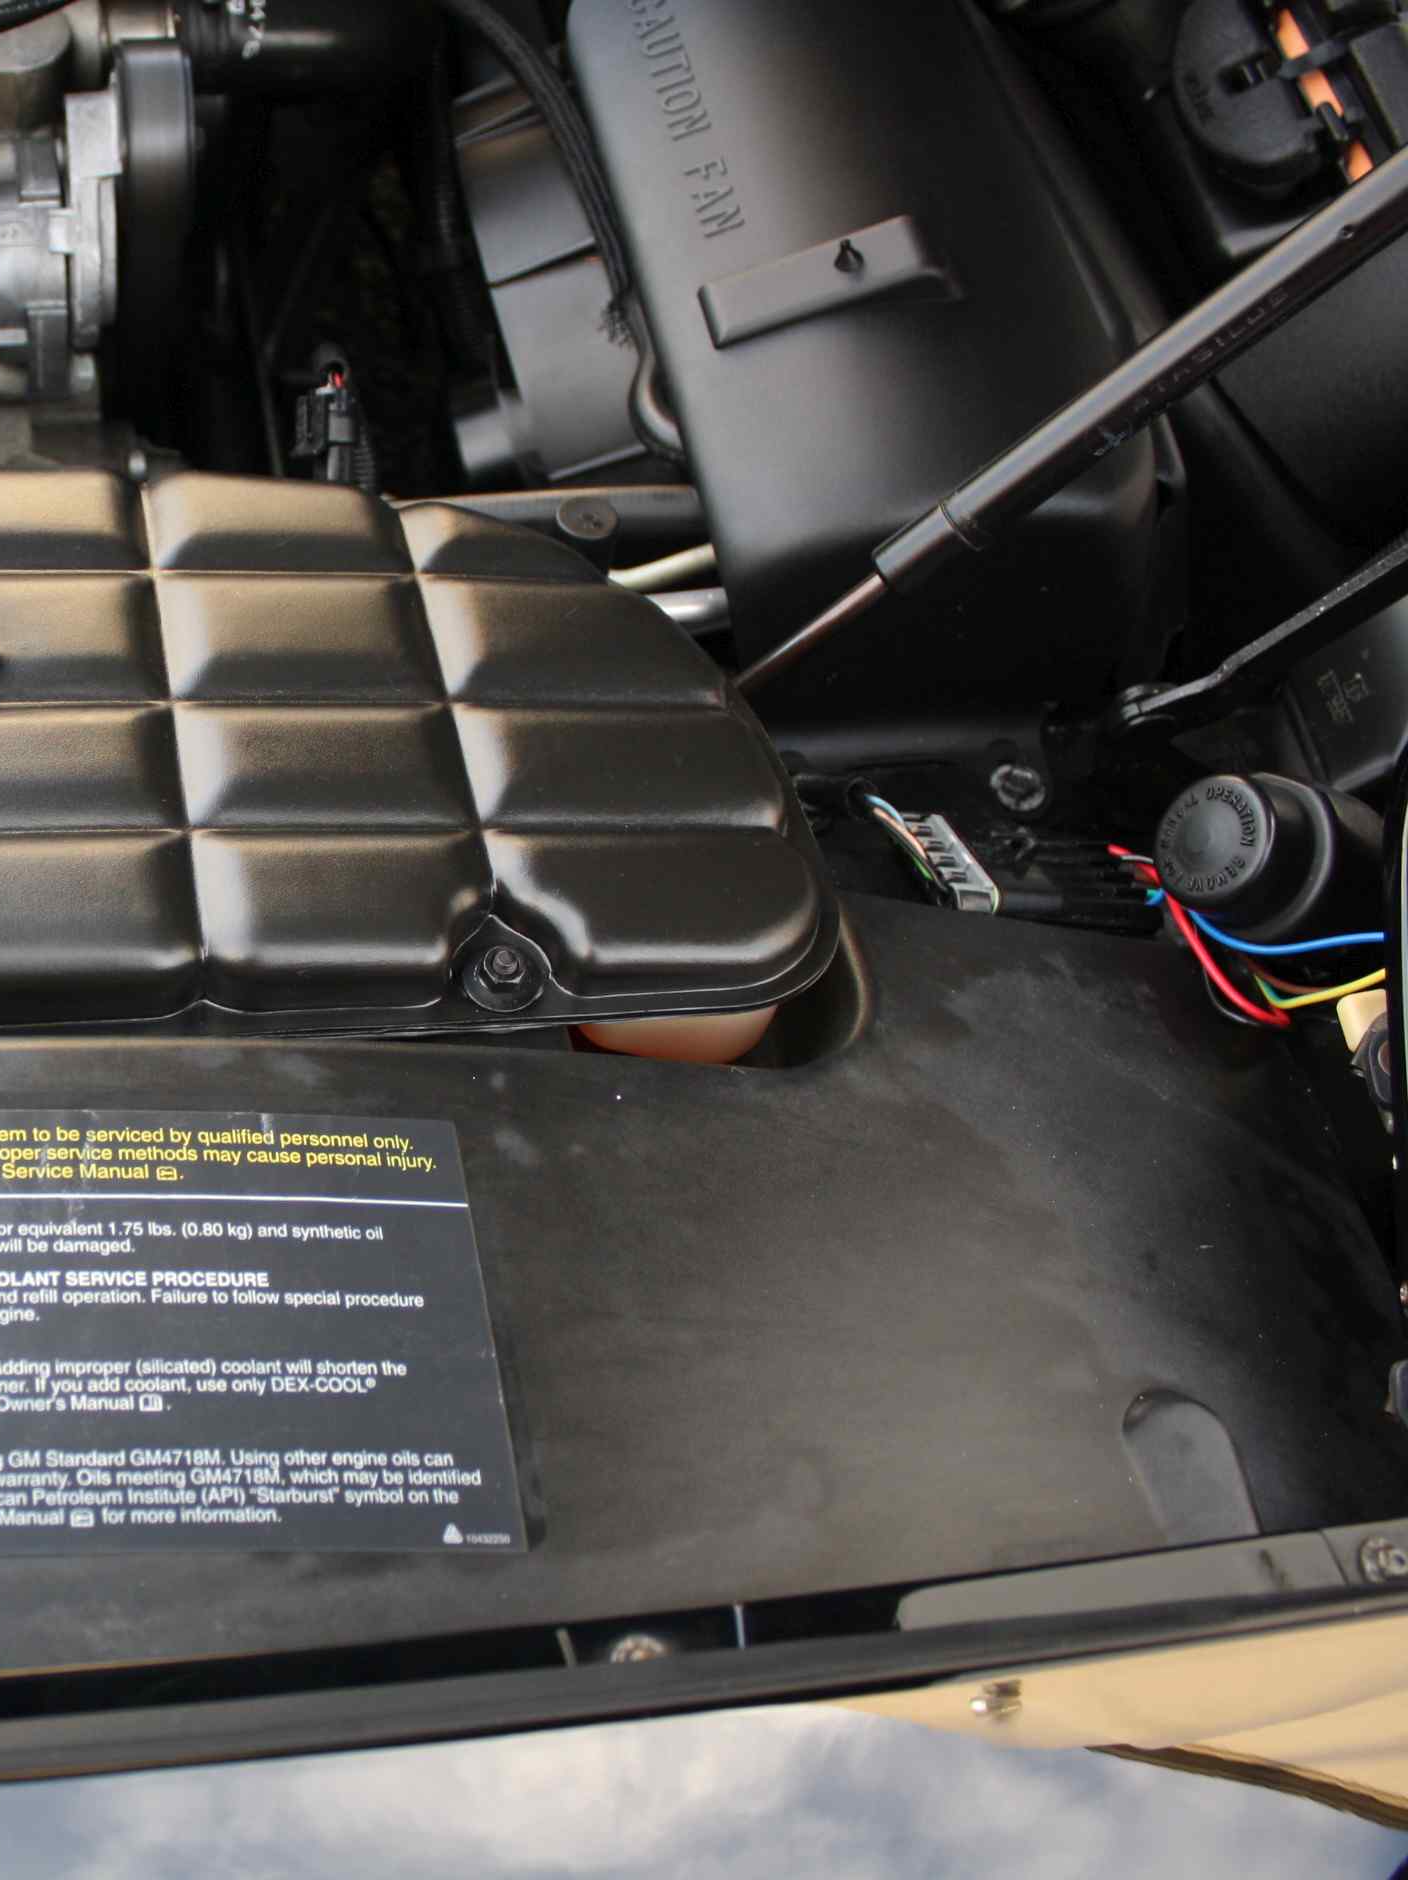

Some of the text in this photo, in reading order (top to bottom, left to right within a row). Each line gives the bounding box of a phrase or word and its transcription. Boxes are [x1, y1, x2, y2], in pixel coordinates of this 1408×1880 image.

[684, 156, 745, 238] FAN
[1205, 784, 1257, 848] OPERATION
[32, 1127, 51, 1143] to
[55, 1127, 80, 1143] be
[85, 1127, 164, 1144] serviced
[168, 1129, 192, 1148] by
[196, 1129, 275, 1150] qualified
[279, 1131, 368, 1152] personnel
[372, 1133, 414, 1152] only.
[44, 1145, 113, 1161] service
[117, 1146, 198, 1162] methods
[202, 1149, 242, 1166] may
[246, 1150, 302, 1164] cause
[305, 1149, 382, 1171] personal
[386, 1152, 437, 1172] injury.
[1, 1164, 74, 1179] Service
[78, 1164, 150, 1179] Manual
[16, 1220, 103, 1239] equivalent
[107, 1220, 144, 1236] 1.75
[147, 1221, 176, 1236] lbs.
[180, 1221, 224, 1239] (0.80
[226, 1222, 253, 1241] kg)
[257, 1222, 288, 1238] and
[291, 1223, 362, 1243] synthetic
[364, 1225, 384, 1240] oil
[26, 1238, 49, 1253] be
[52, 1237, 136, 1256] damaged.
[64, 1271, 148, 1287] SERVICE
[151, 1271, 270, 1287] PROCEDURE
[22, 1289, 58, 1304] refill
[61, 1289, 146, 1307] operation.
[150, 1289, 208, 1304] Failure
[211, 1289, 229, 1305] to
[232, 1290, 280, 1305] follow
[283, 1291, 341, 1310] special
[344, 1291, 425, 1310] procedure
[54, 1359, 132, 1378] improper
[134, 1359, 217, 1377] (silicated)
[220, 1359, 282, 1375] coolant
[284, 1359, 312, 1375] will
[316, 1359, 378, 1375] shorten
[380, 1360, 408, 1376] the
[34, 1378, 46, 1393] If
[49, 1380, 83, 1397] you
[86, 1377, 120, 1392] add
[123, 1377, 192, 1395] coolant,
[195, 1379, 228, 1392] use
[230, 1377, 266, 1396] only
[70, 1395, 135, 1411] Manual
[6, 1451, 41, 1468] GM
[44, 1450, 126, 1467] Standard
[128, 1450, 226, 1466] GM4718M.
[229, 1450, 280, 1469] Using
[283, 1450, 328, 1466] other
[331, 1450, 388, 1469] engine
[390, 1450, 420, 1466] oils
[422, 1453, 455, 1466] can
[75, 1469, 112, 1486] Oils
[115, 1468, 186, 1489] meeting
[189, 1468, 286, 1487] GM4718M,
[288, 1468, 339, 1484] which
[342, 1471, 378, 1488] may
[381, 1468, 404, 1484] be
[407, 1468, 482, 1485] identified
[32, 1488, 124, 1506] Petroleum
[126, 1487, 196, 1504] Institute
[200, 1487, 246, 1505] (API)
[344, 1487, 404, 1507] symbol
[406, 1490, 430, 1503] on
[432, 1487, 460, 1503] the
[101, 1508, 126, 1524] for
[130, 1510, 176, 1524] more
[180, 1506, 283, 1523] information.
